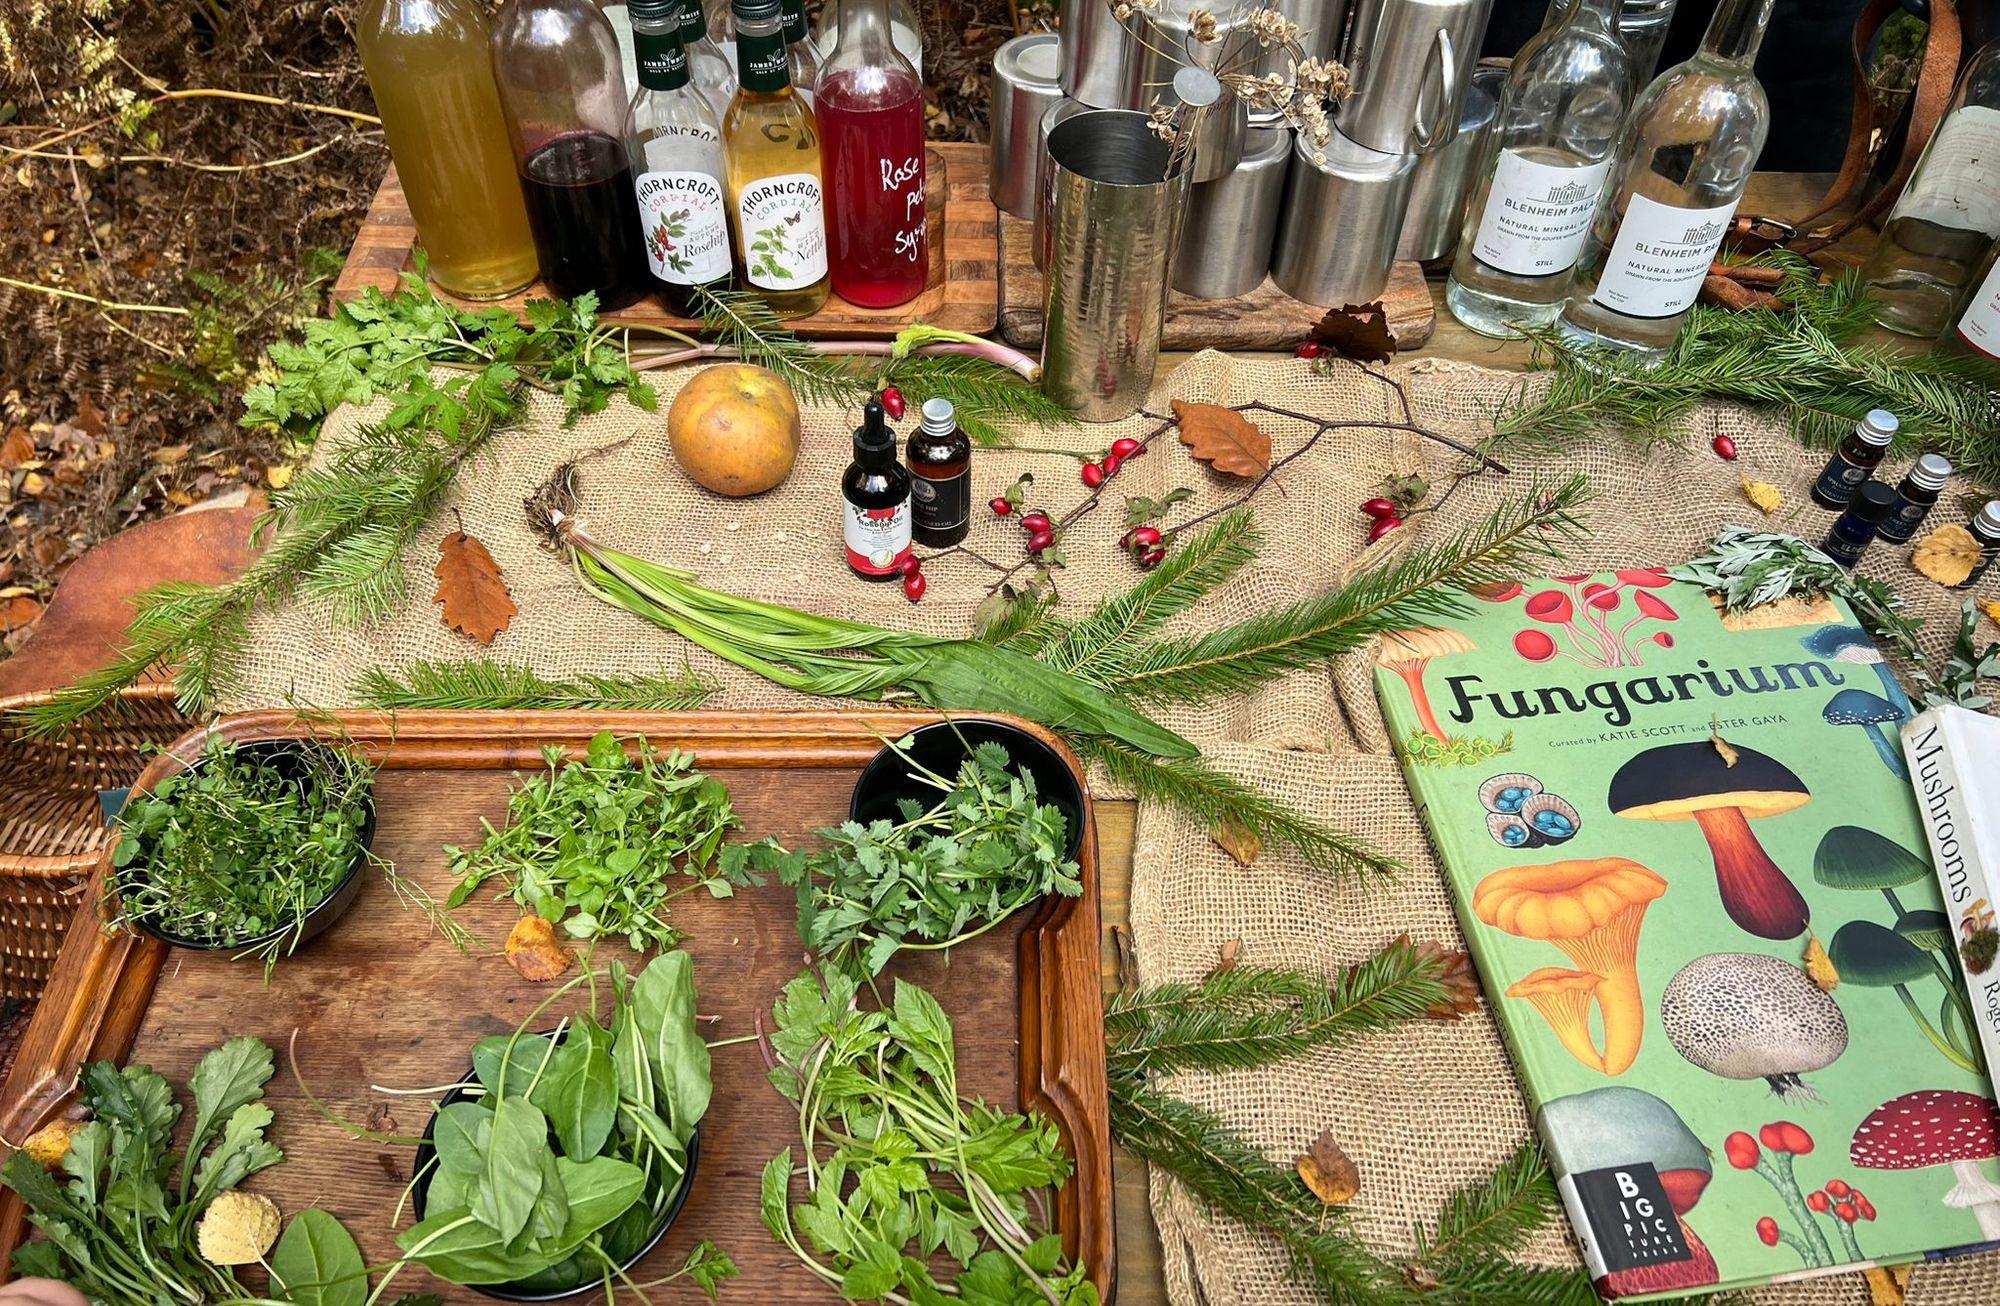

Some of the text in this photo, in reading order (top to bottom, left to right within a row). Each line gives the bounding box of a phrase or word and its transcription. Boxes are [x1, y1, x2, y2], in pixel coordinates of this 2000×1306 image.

[782, 13, 799, 21] HITE
[880, 157, 919, 191] Rose
[637, 178, 720, 206] THORNCROFT
[649, 193, 706, 213] CORDIAL
[742, 182, 821, 216] THORNCROFT
[756, 198, 812, 221] CORDIAL
[1504, 198, 1596, 217] BLENHEIM PALA
[1499, 215, 1539, 232] NATURAL
[1542, 223, 1577, 233] MINERAL
[684, 230, 726, 258] Rosehip
[1635, 240, 1719, 259] BLENHEIM PAL
[1627, 260, 1671, 275] NATURAL
[1664, 299, 1682, 308] STILL
[1445, 660, 1845, 726] Fungarium
[1548, 714, 1788, 747] Curated by KATIE SCOTT and ESTER GAYA
[1910, 723, 1972, 903] Mushrooms
